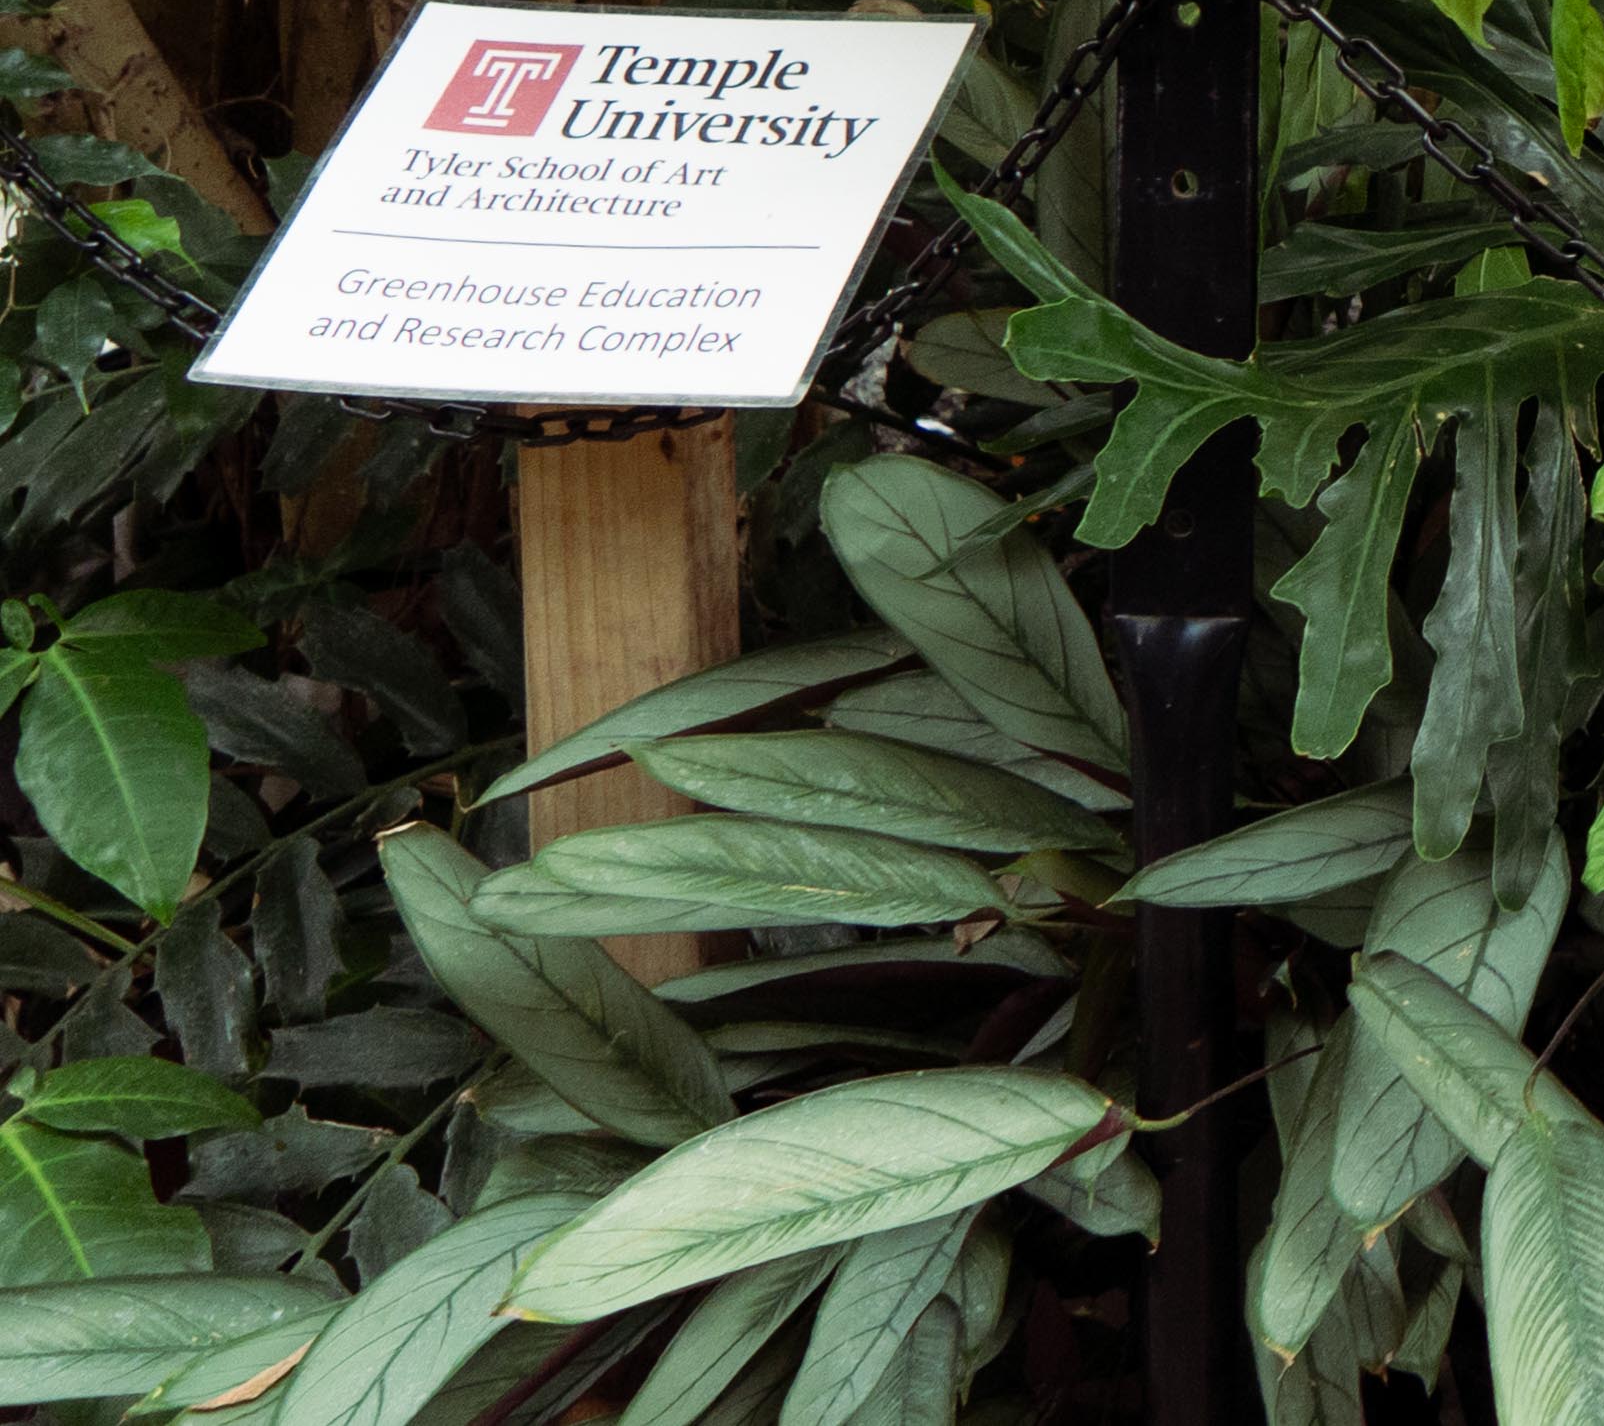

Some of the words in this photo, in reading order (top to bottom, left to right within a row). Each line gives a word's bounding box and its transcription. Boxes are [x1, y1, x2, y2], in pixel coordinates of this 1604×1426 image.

[590, 44, 809, 100] Temple
[560, 99, 879, 159] University
[402, 148, 491, 180] Tyler
[498, 156, 615, 182] School
[621, 160, 665, 184] of
[664, 162, 728, 186] Art
[380, 185, 451, 207] and
[456, 187, 682, 217] Architecture
[337, 268, 567, 307] Greenhouse
[578, 280, 761, 308] Education
[308, 313, 389, 341] and
[393, 316, 566, 351] Research
[578, 323, 742, 358] Complex
